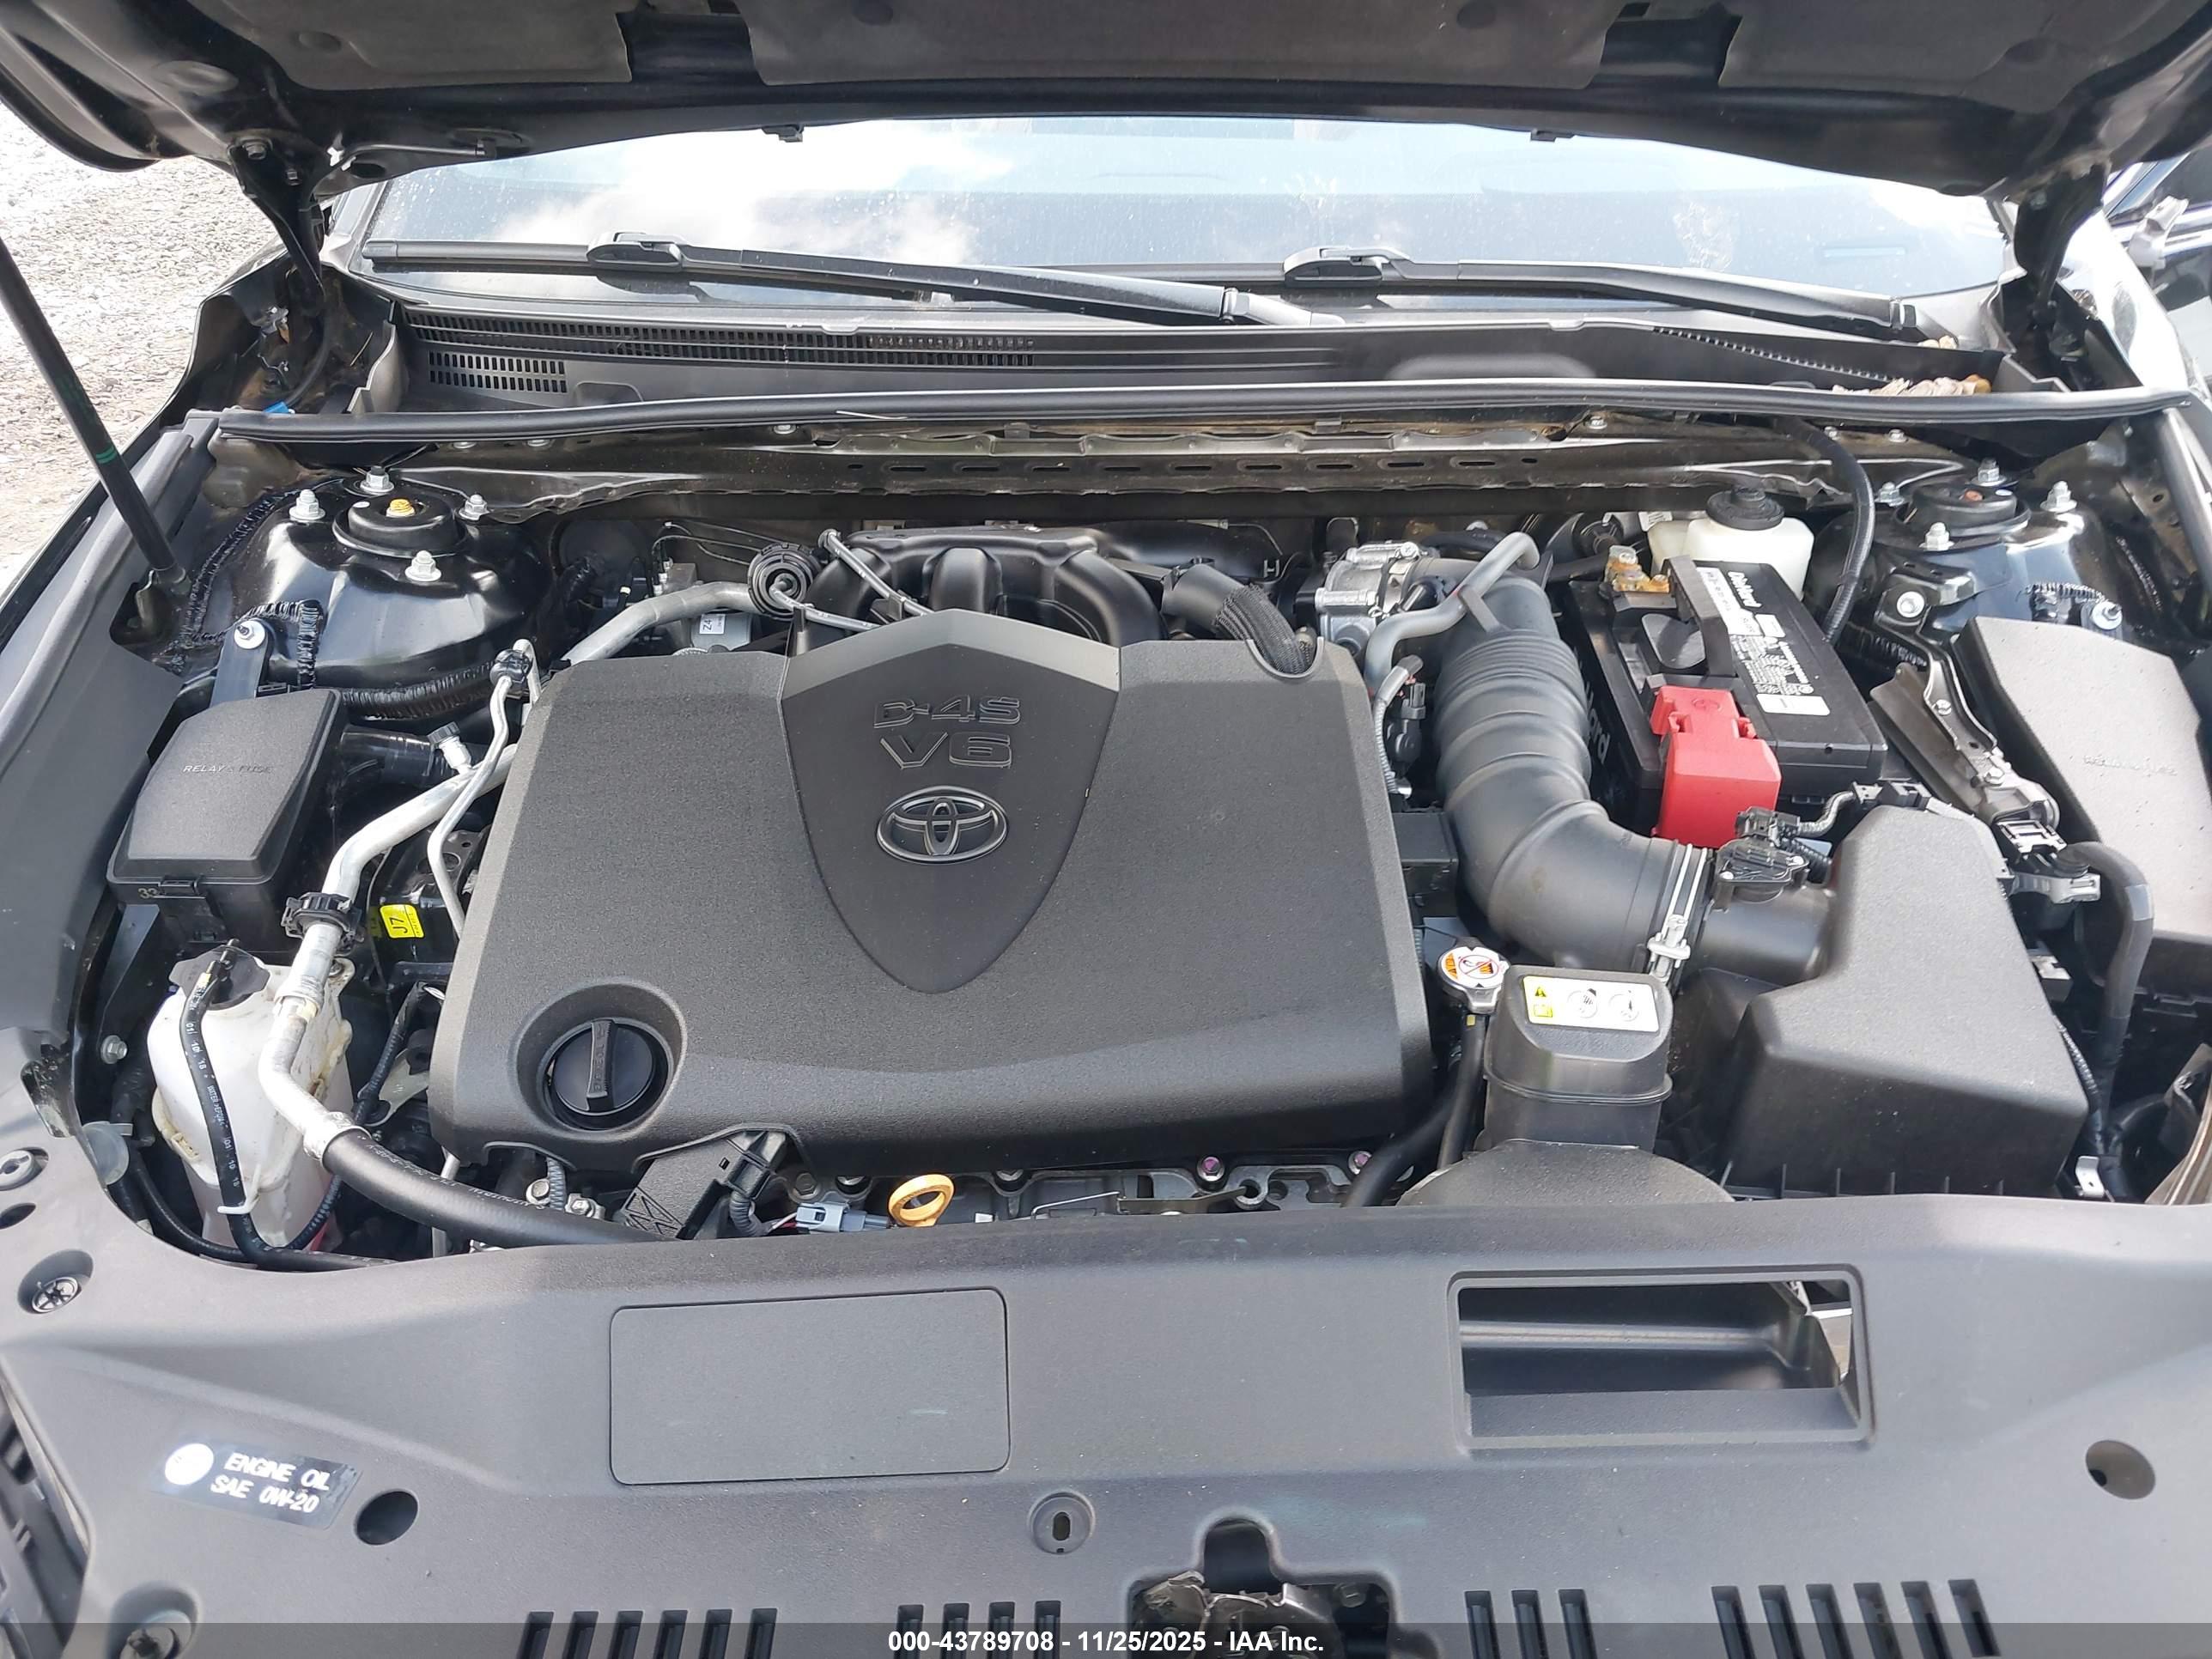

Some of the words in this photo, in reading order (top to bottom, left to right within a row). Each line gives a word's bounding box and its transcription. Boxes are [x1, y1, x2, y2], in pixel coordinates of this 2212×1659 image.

[702, 619, 713, 630] Z4
[873, 694, 1020, 728] D-4S
[880, 731, 1012, 769] V6
[182, 764, 227, 773] RELAY
[389, 916, 408, 933] J7
[223, 1453, 296, 1483] ENGINE
[301, 1468, 331, 1491] OIL
[210, 1474, 254, 1498] SAE
[259, 1486, 320, 1513] 0W-20
